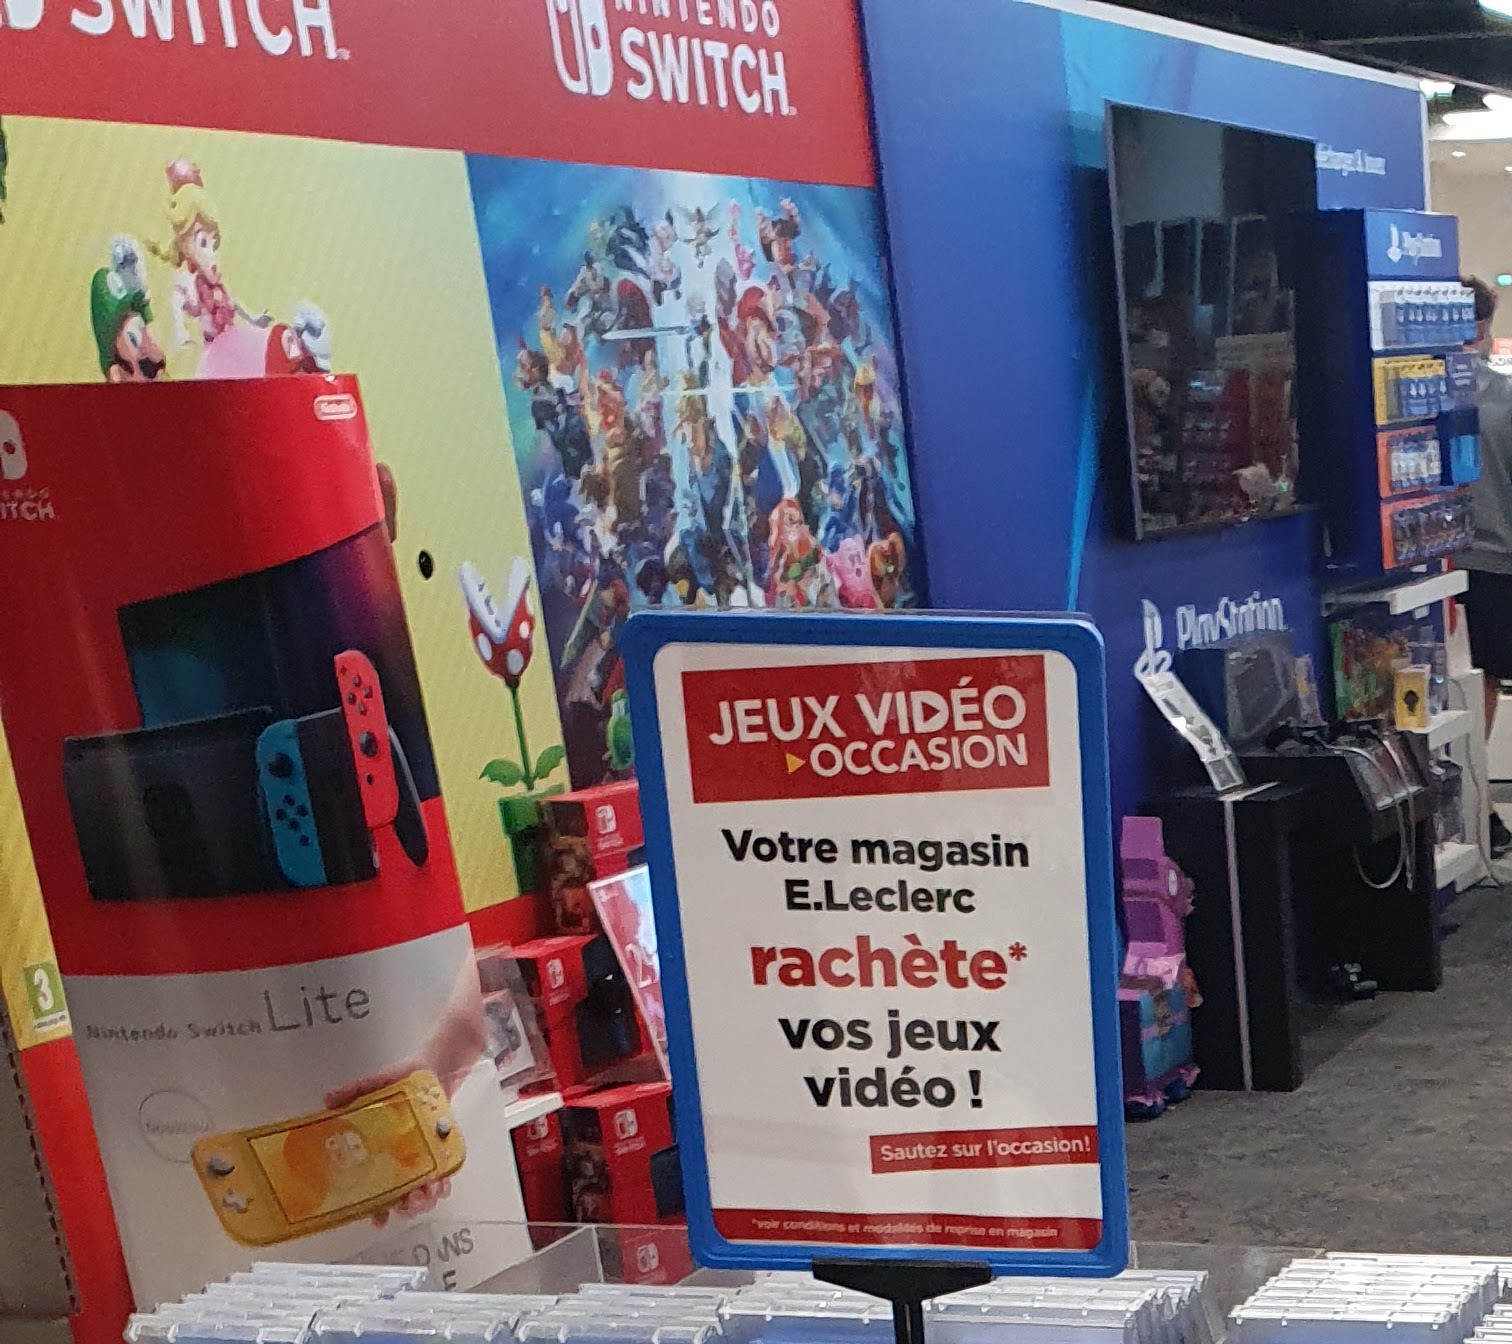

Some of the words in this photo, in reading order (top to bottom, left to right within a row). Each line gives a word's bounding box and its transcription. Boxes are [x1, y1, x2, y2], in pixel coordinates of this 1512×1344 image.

[614, 0, 780, 37] TENDO
[620, 27, 789, 116] SWITCH
[0, 500, 55, 520] ITCH
[708, 695, 846, 746] JEUX
[855, 676, 1027, 738] VIDÉO
[810, 734, 1028, 778] OCCASION
[720, 828, 838, 864] Votre
[851, 833, 1030, 872] magasin
[785, 879, 976, 914] E.Leclerc
[33, 968, 55, 1011] 3
[86, 1022, 179, 1042] Nintendo
[187, 1019, 262, 1038] Switch
[264, 985, 371, 1032] Lite
[778, 1016, 873, 1051] vos
[886, 1009, 1002, 1059] jeux
[803, 1066, 957, 1108] vidéo
[880, 1142, 948, 1163] Sautez
[951, 1142, 984, 1159] sur
